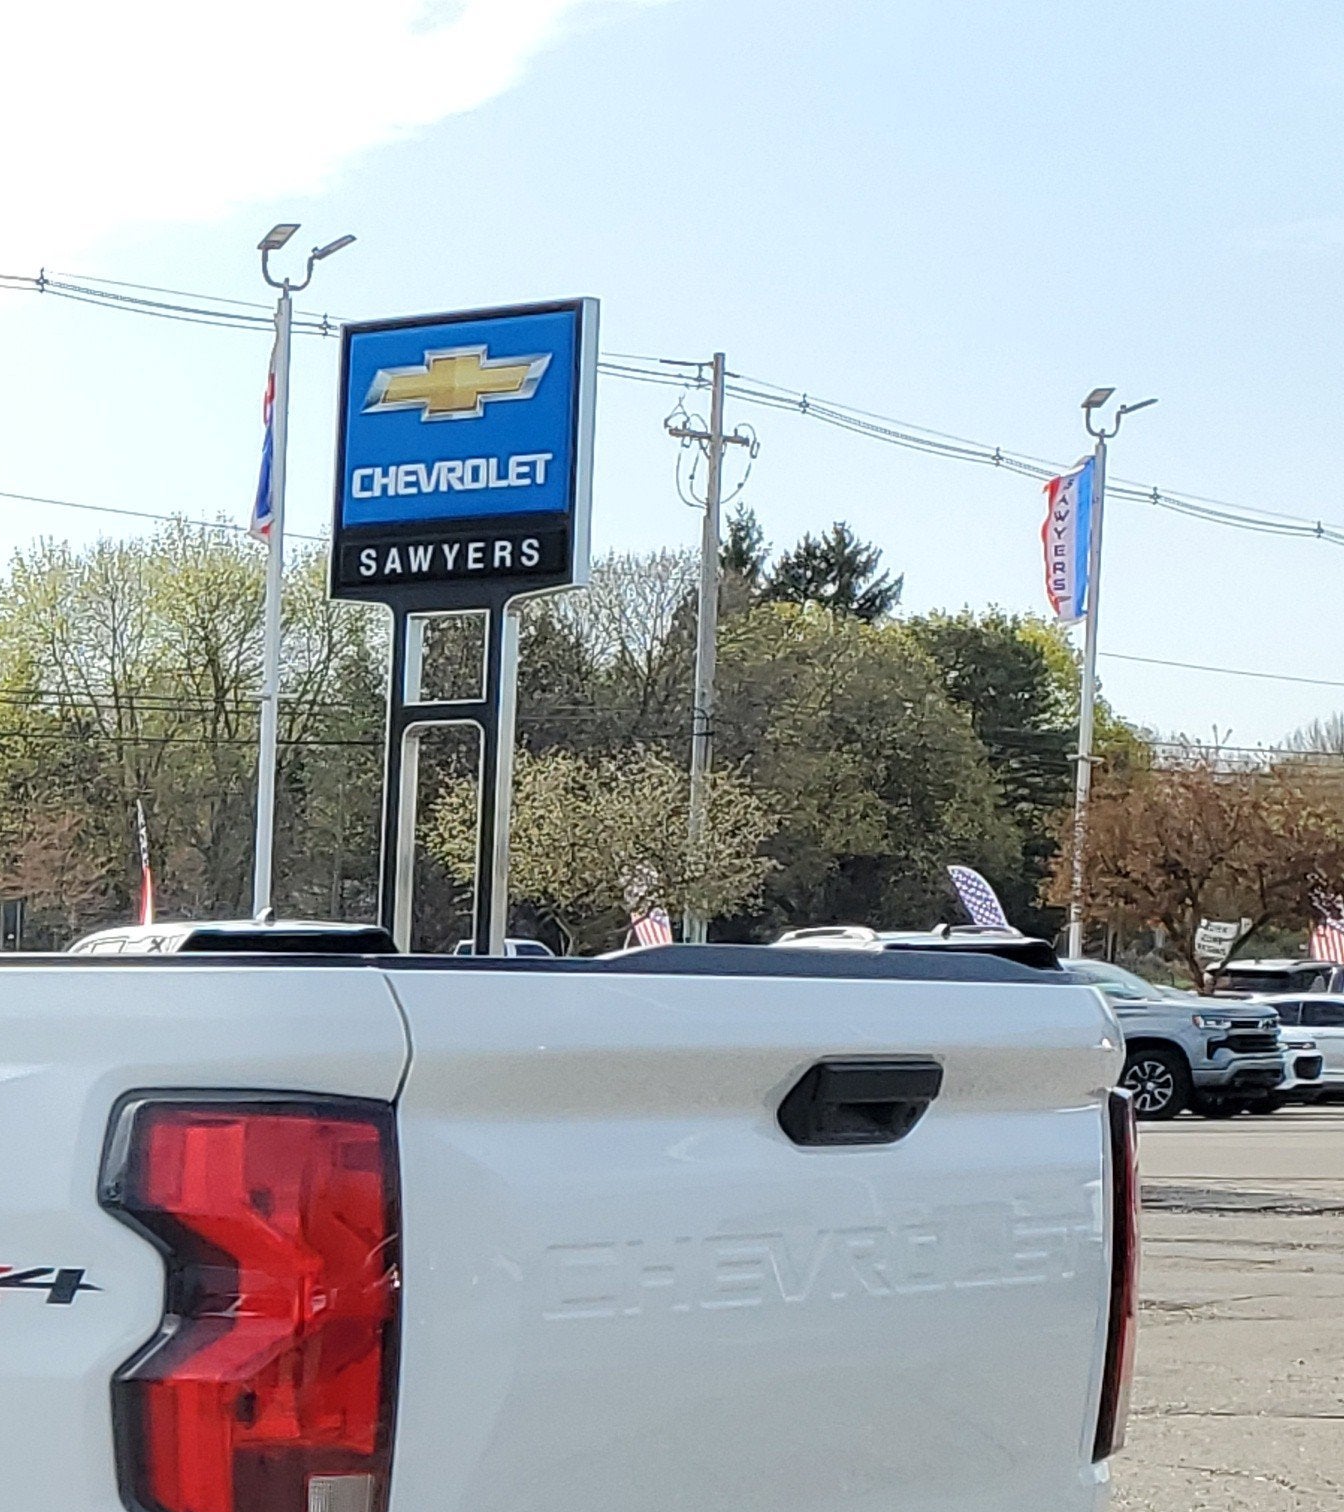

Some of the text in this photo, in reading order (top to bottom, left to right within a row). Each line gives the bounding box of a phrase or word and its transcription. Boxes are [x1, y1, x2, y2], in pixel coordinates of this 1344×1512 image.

[351, 452, 553, 499] CHEVROLET
[358, 538, 541, 577] SAWYERS
[1052, 477, 1076, 592] SAWYERS
